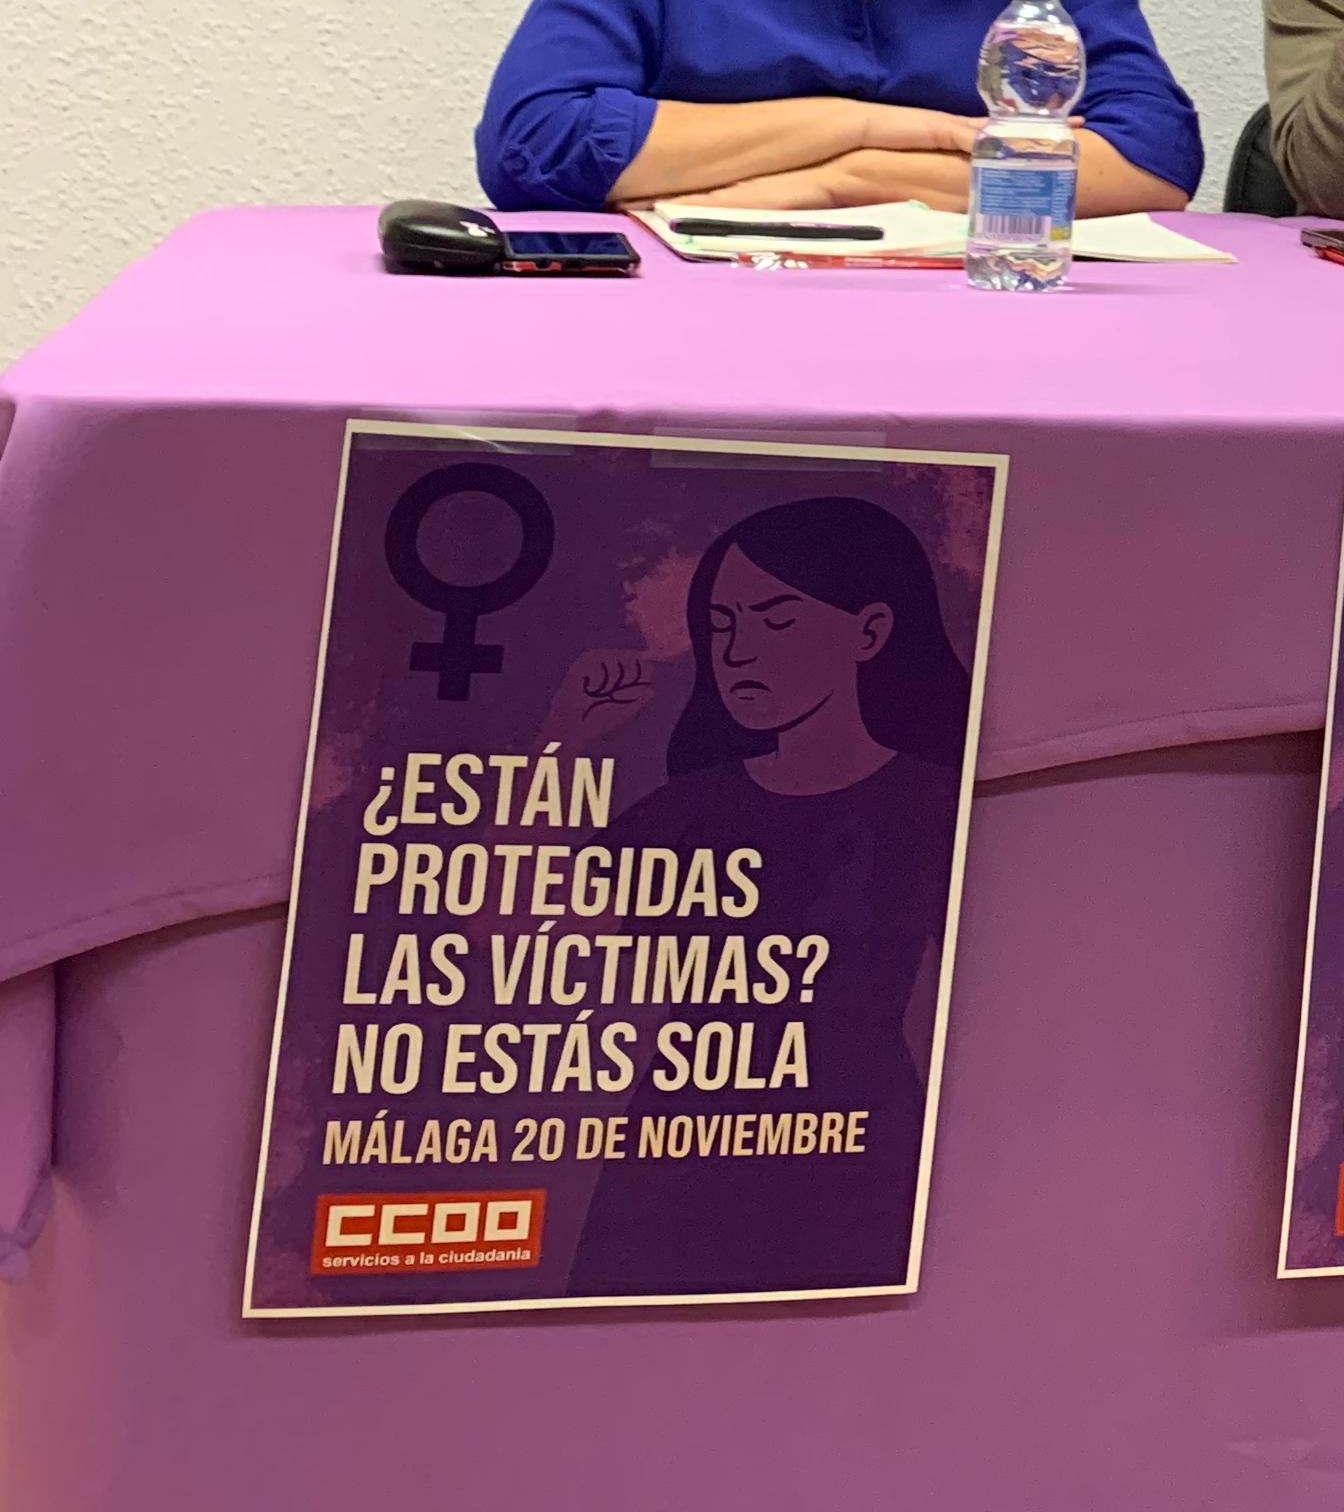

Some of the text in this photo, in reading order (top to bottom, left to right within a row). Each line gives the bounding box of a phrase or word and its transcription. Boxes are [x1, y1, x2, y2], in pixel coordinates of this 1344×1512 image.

[364, 742, 614, 835] ¿ESTÁN
[354, 843, 762, 917] PROTEGIDAS
[343, 921, 829, 1005] LAS VÍCTIMAS?
[333, 1010, 808, 1094] NO ESTÁS SOLA
[323, 1110, 868, 1164] MÁLAGA 20 DE NOVIEMBRE
[322, 1252, 399, 1267] servicios
[405, 1254, 415, 1265] a
[420, 1251, 434, 1264] la
[326, 1201, 531, 1246] CCOO
